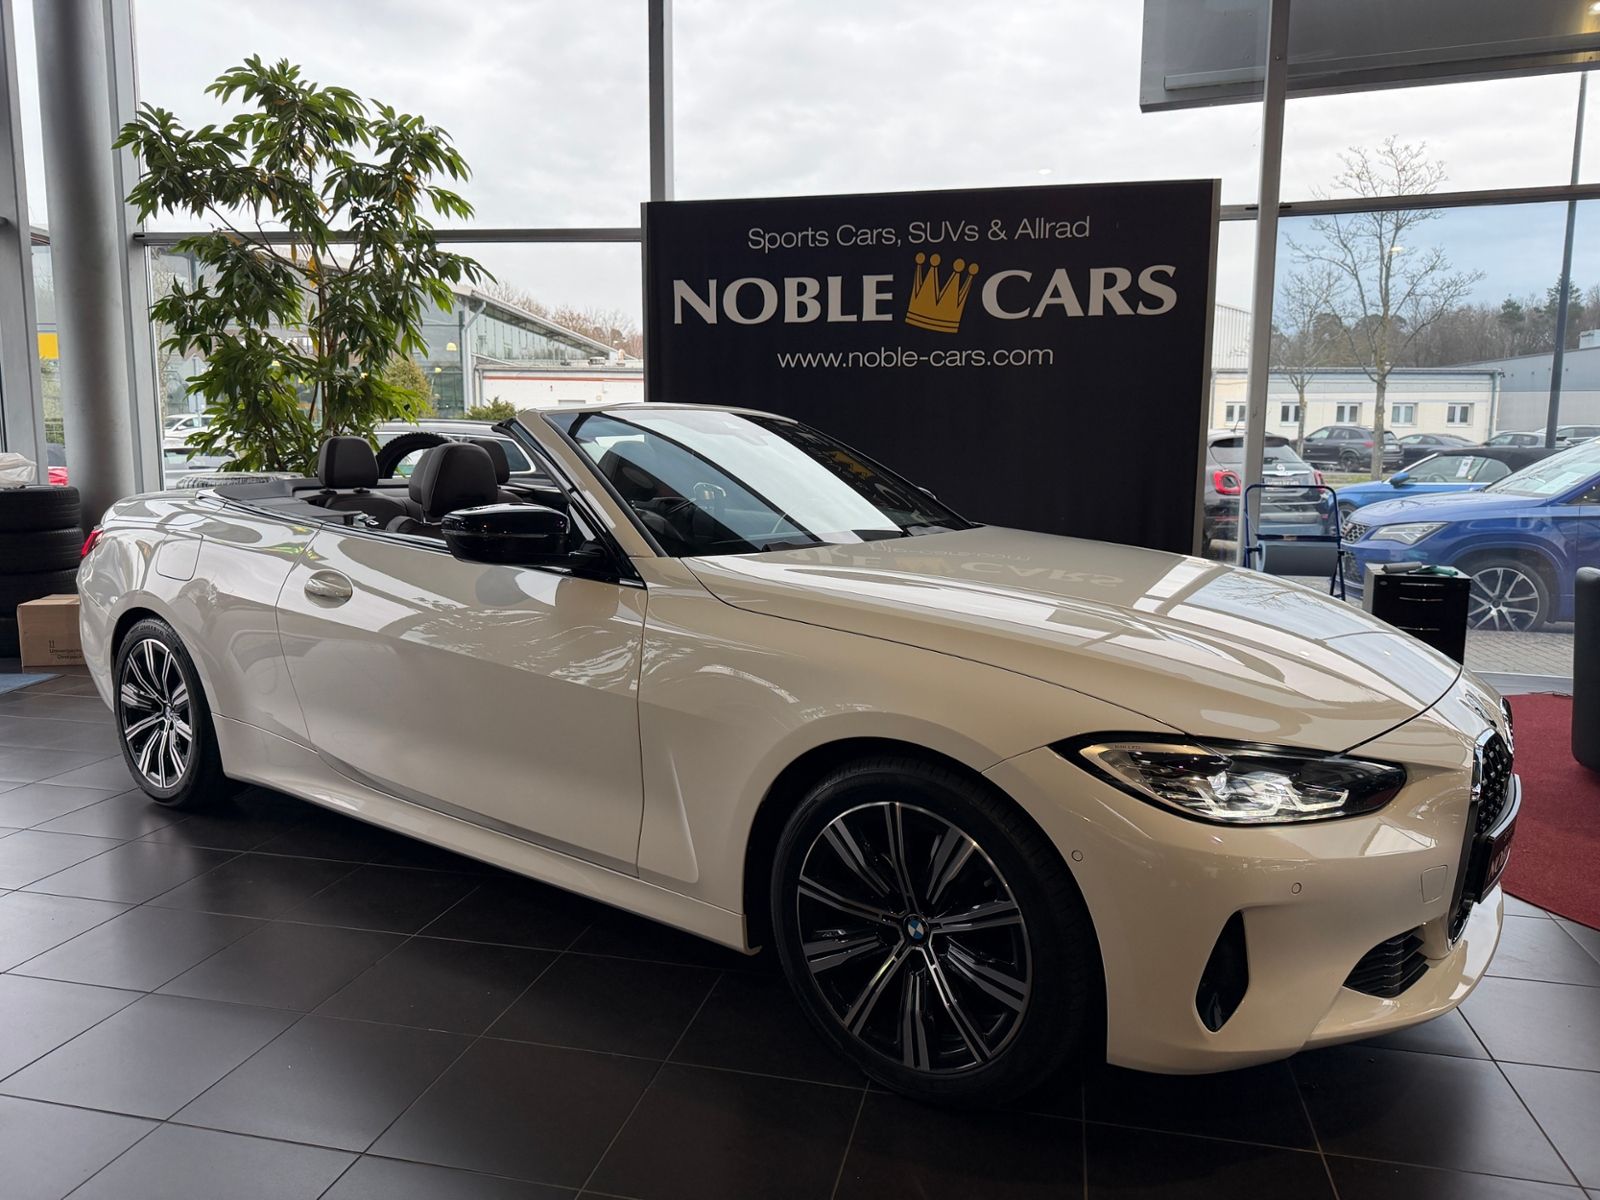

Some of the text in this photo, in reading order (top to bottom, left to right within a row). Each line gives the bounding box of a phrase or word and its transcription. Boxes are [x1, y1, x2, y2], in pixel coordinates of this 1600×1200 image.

[748, 215, 1090, 254] Sports Cars, SUVs & Allrad
[672, 264, 1178, 326] NOBLE CARS
[777, 345, 1054, 369] www.noble-cars.com
